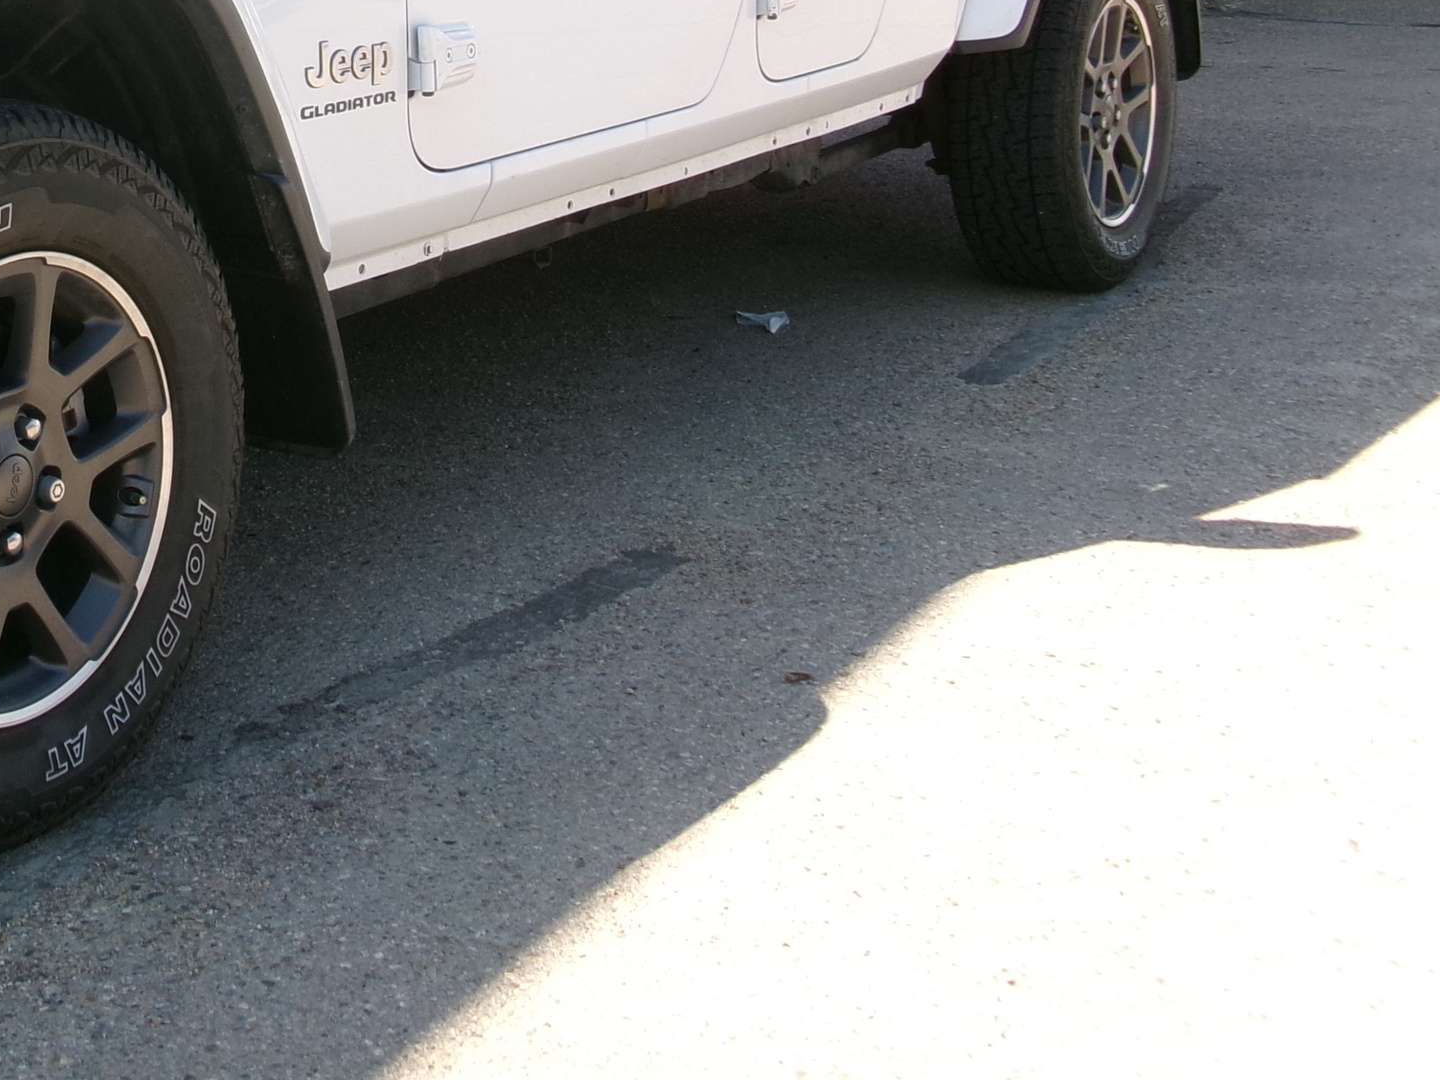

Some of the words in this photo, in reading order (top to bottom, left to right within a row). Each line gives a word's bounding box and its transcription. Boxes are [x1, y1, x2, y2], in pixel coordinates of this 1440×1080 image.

[303, 39, 393, 89] Jeep
[300, 90, 396, 121] GLADIATOR
[104, 498, 217, 736] ROADIAN
[45, 724, 88, 782] AT
